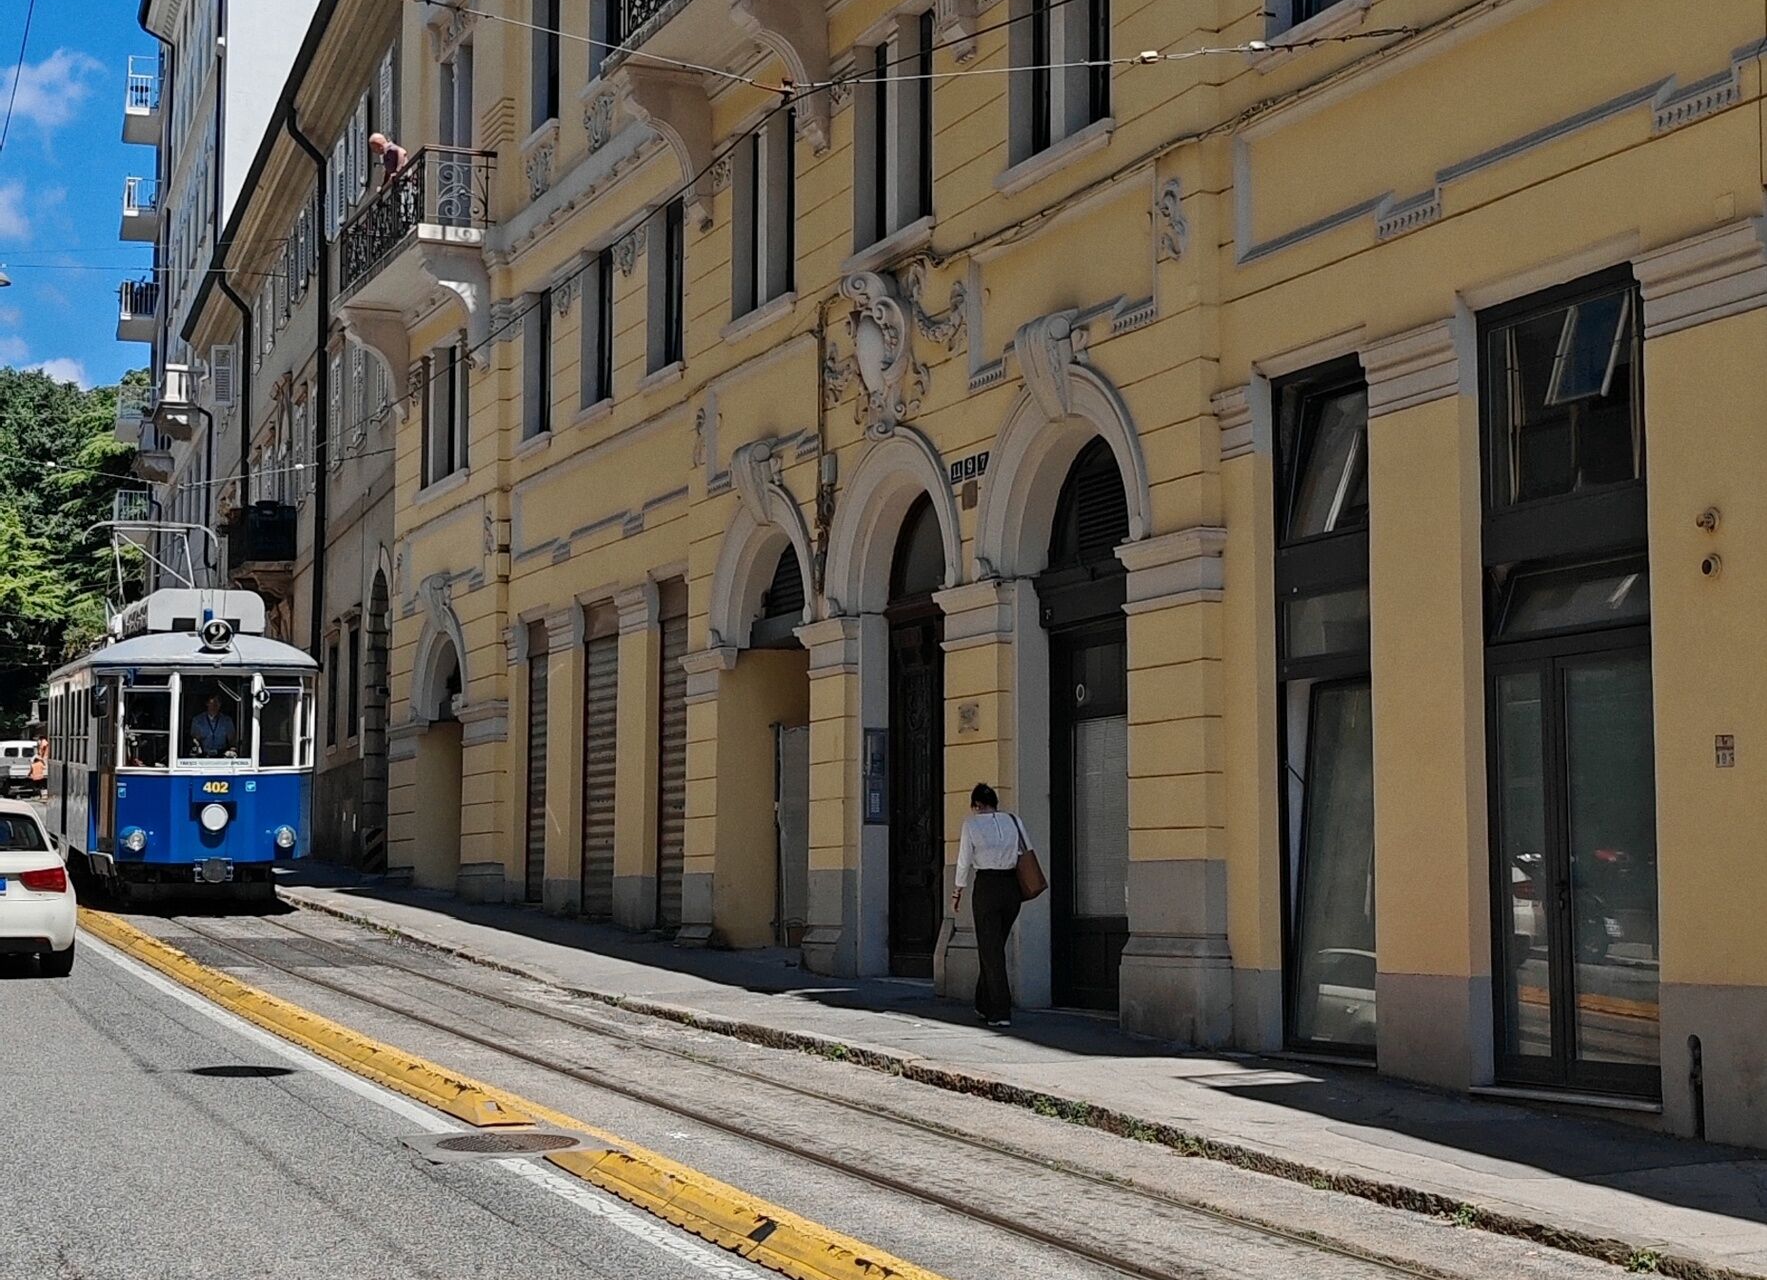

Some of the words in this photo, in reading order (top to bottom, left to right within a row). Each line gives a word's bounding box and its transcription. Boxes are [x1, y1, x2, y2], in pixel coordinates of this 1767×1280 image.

[967, 459, 973, 473] 9
[210, 622, 227, 644] 2
[202, 781, 229, 793] 402
